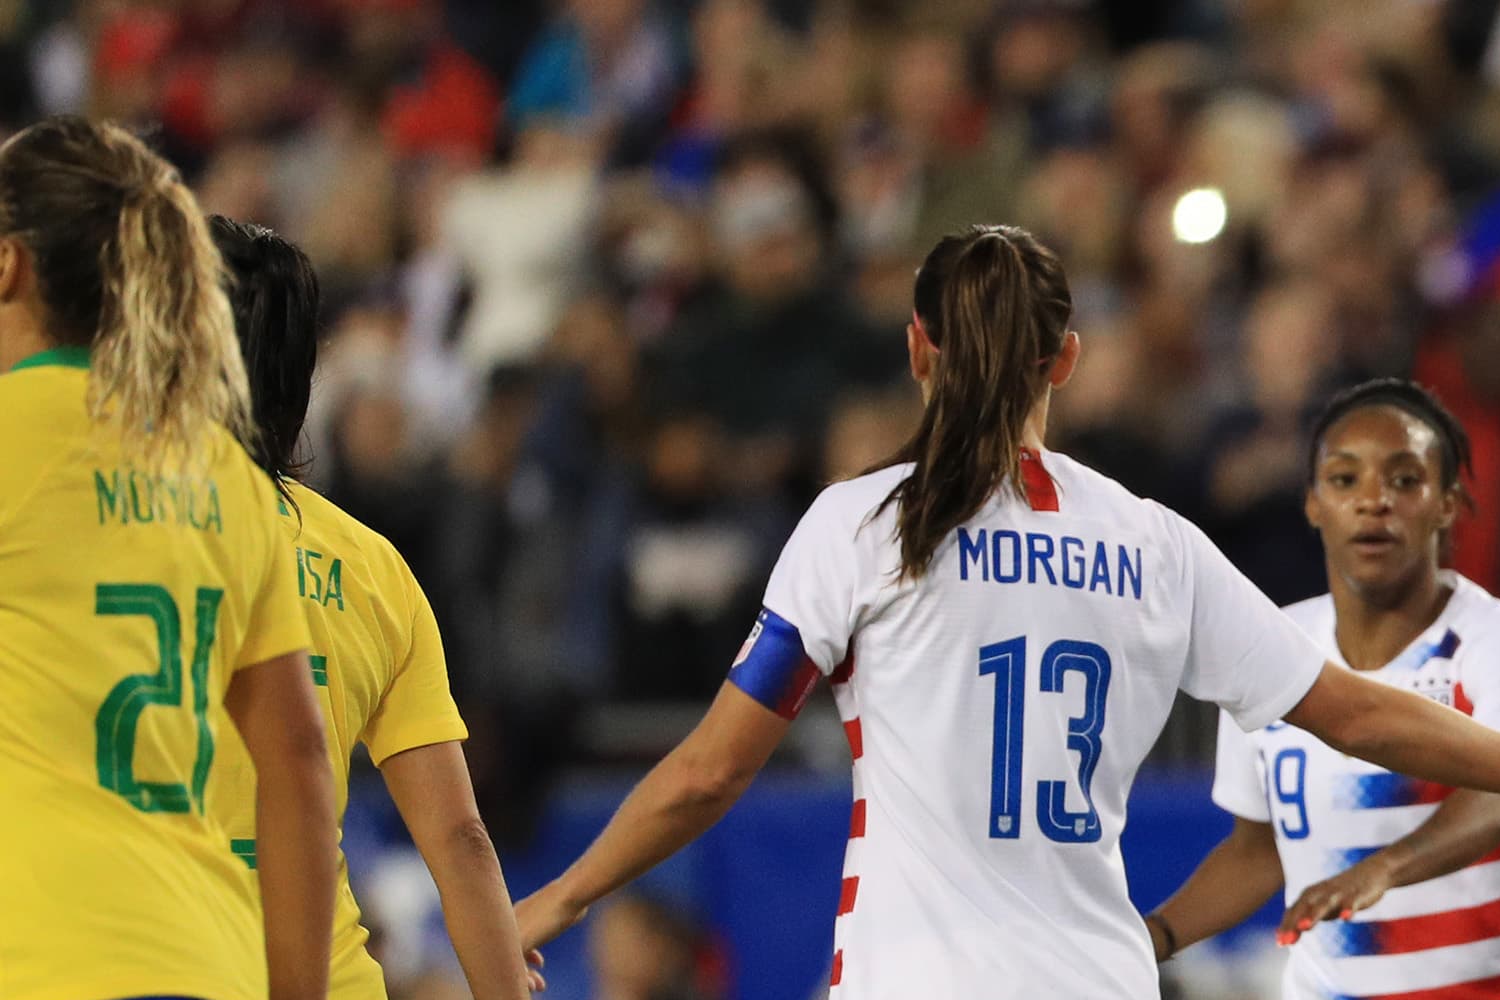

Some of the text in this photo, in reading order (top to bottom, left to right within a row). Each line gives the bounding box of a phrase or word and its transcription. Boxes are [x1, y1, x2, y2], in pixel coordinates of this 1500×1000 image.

[295, 546, 345, 612] ISA
[957, 526, 1142, 600] MORGAN
[94, 582, 224, 817] 21
[978, 635, 1112, 844] 13
[1274, 748, 1310, 840] 9
